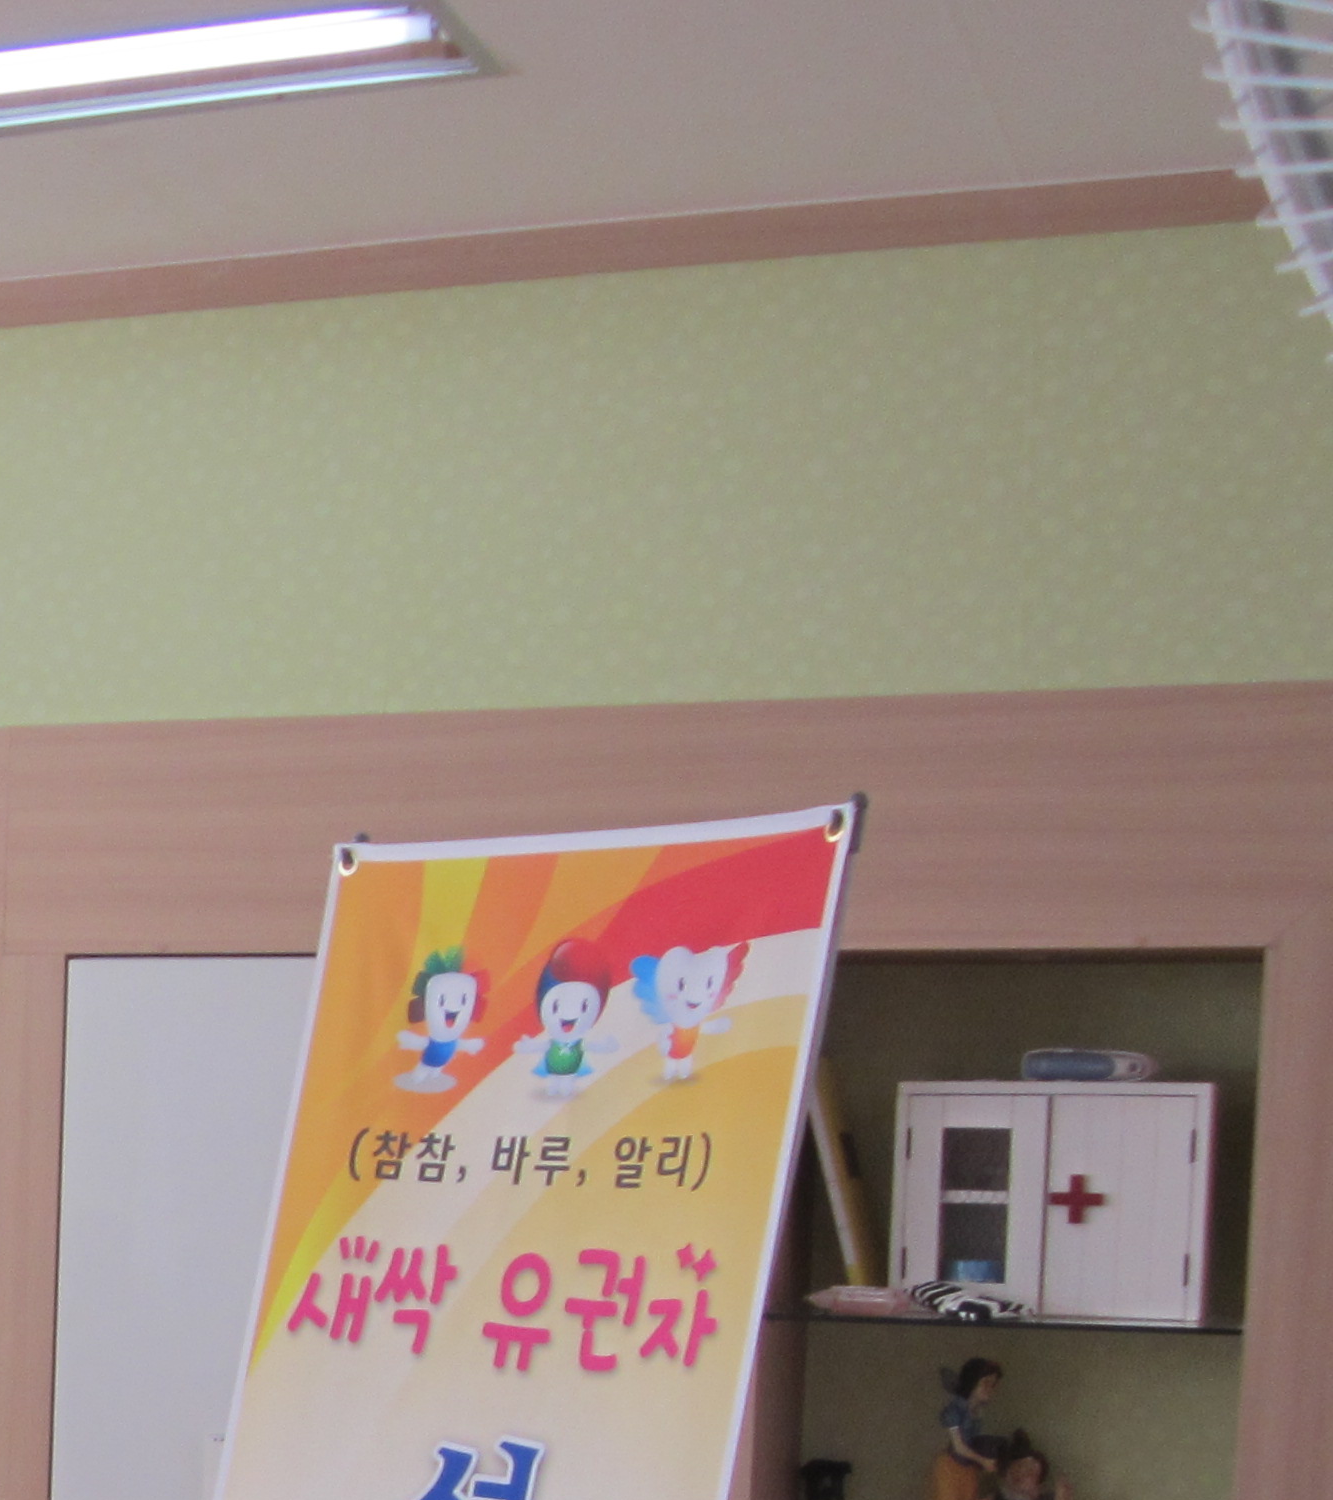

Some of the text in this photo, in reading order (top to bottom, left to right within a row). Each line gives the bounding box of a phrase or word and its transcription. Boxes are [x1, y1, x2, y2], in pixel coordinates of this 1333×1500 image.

[347, 1126, 713, 1192] (참참, 바루, 알리)
[287, 1236, 718, 1372] 새싹 유권자
